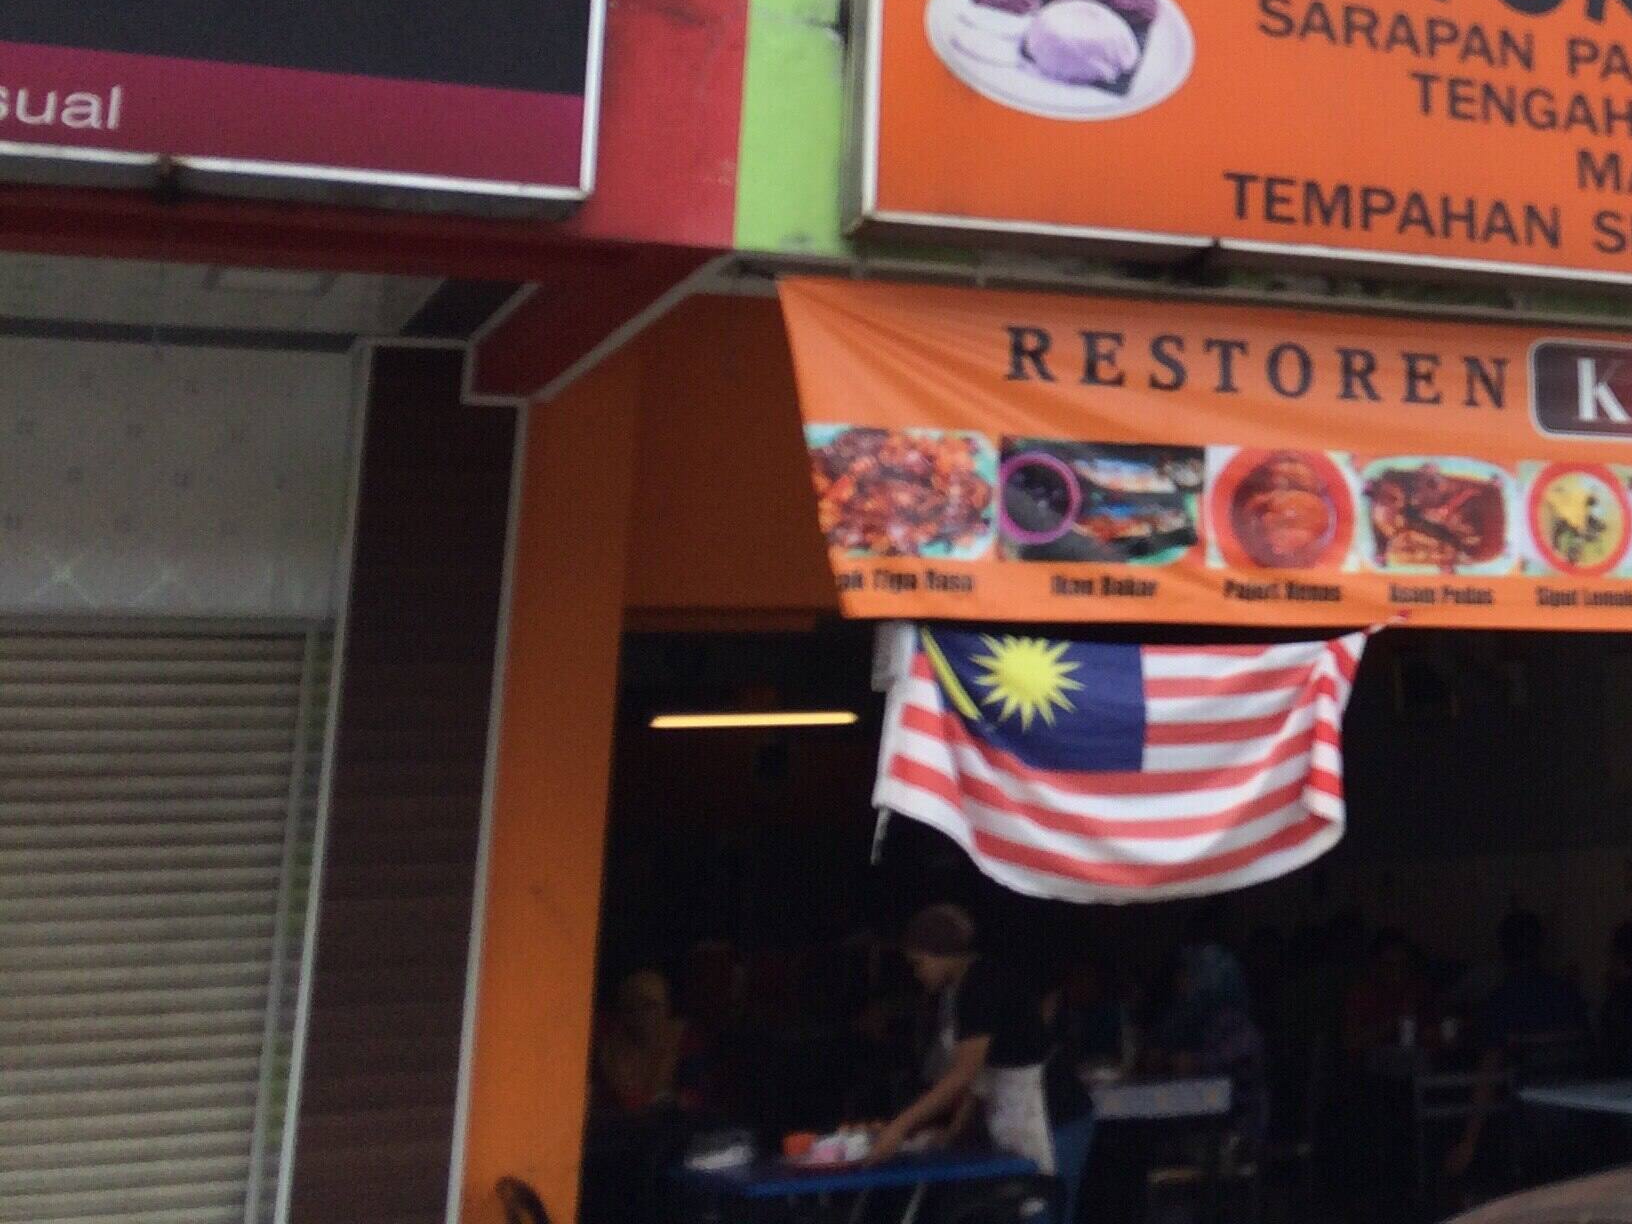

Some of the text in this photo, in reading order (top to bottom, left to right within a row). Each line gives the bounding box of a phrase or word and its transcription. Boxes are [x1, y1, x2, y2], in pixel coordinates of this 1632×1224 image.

[0, 84, 122, 131] ual
[1222, 171, 1562, 250] TEMPAHAN
[1005, 323, 1509, 410] RESTOREN
